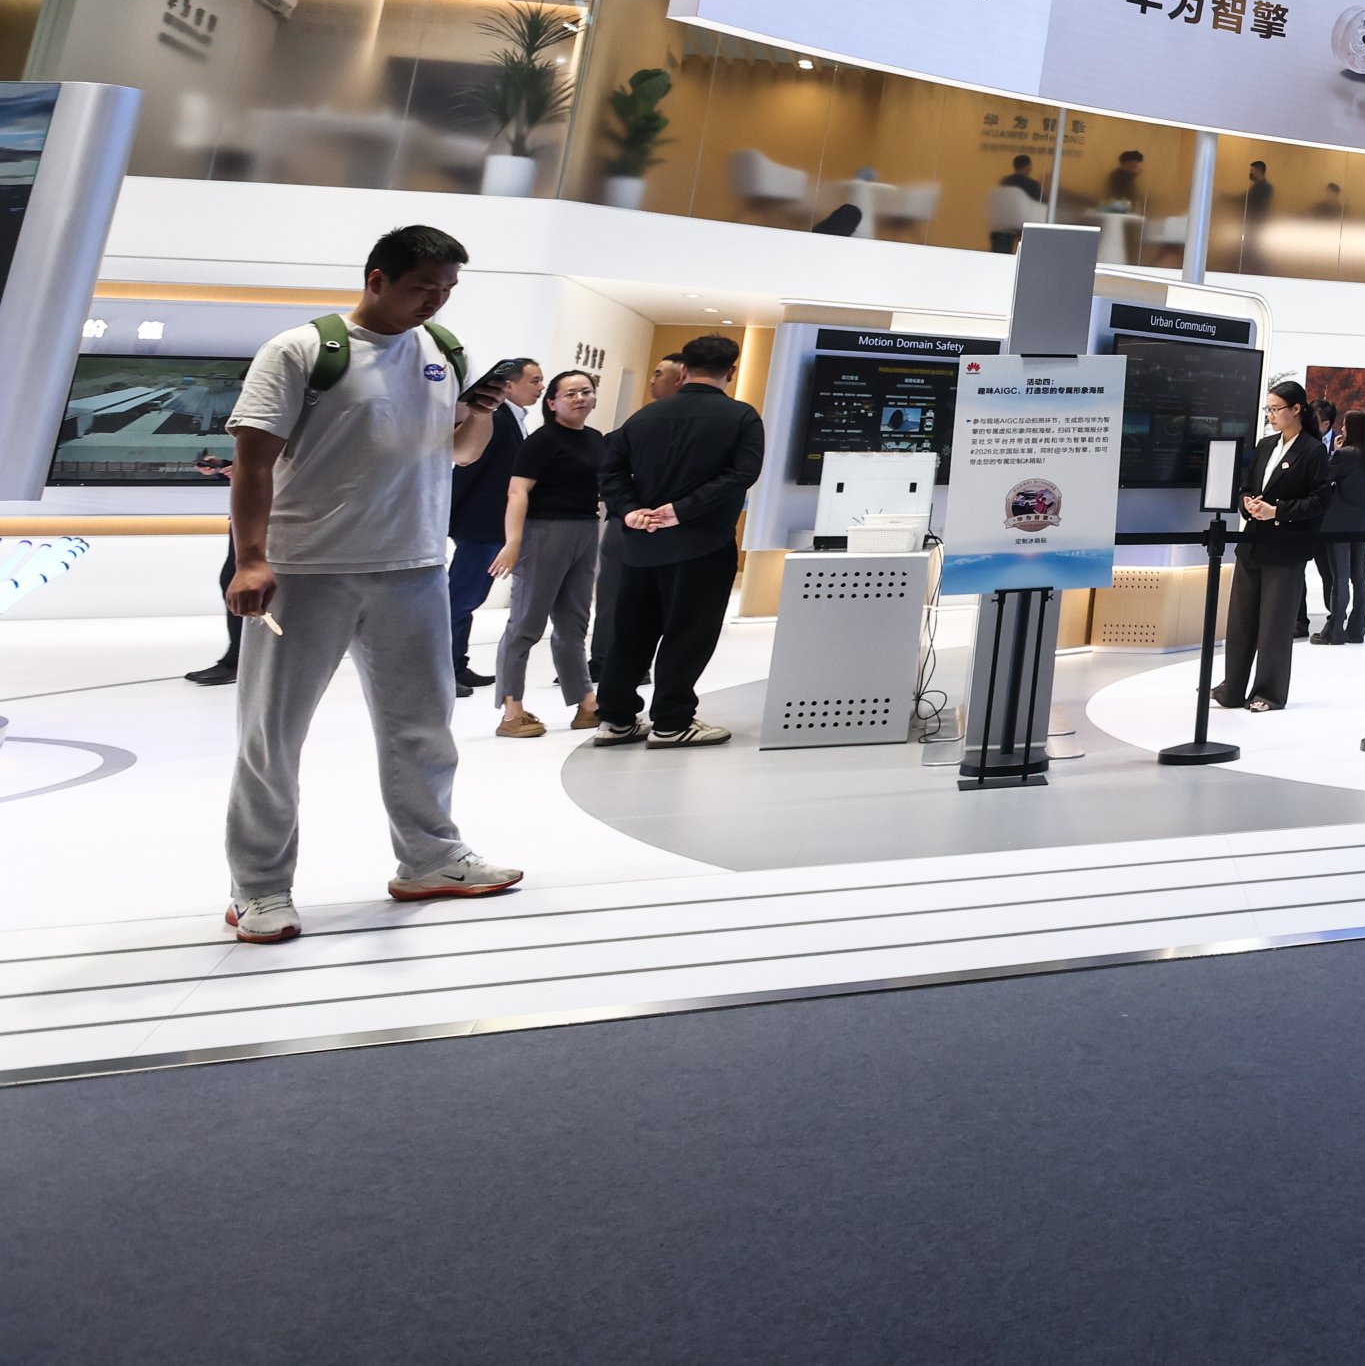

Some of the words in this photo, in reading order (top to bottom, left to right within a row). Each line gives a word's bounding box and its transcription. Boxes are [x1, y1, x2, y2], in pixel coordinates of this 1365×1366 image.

[1150, 315, 1174, 329] Urban
[1175, 318, 1217, 336] Commuting
[858, 336, 894, 347] Motion
[896, 338, 933, 350] Domain
[935, 340, 964, 354] Safety
